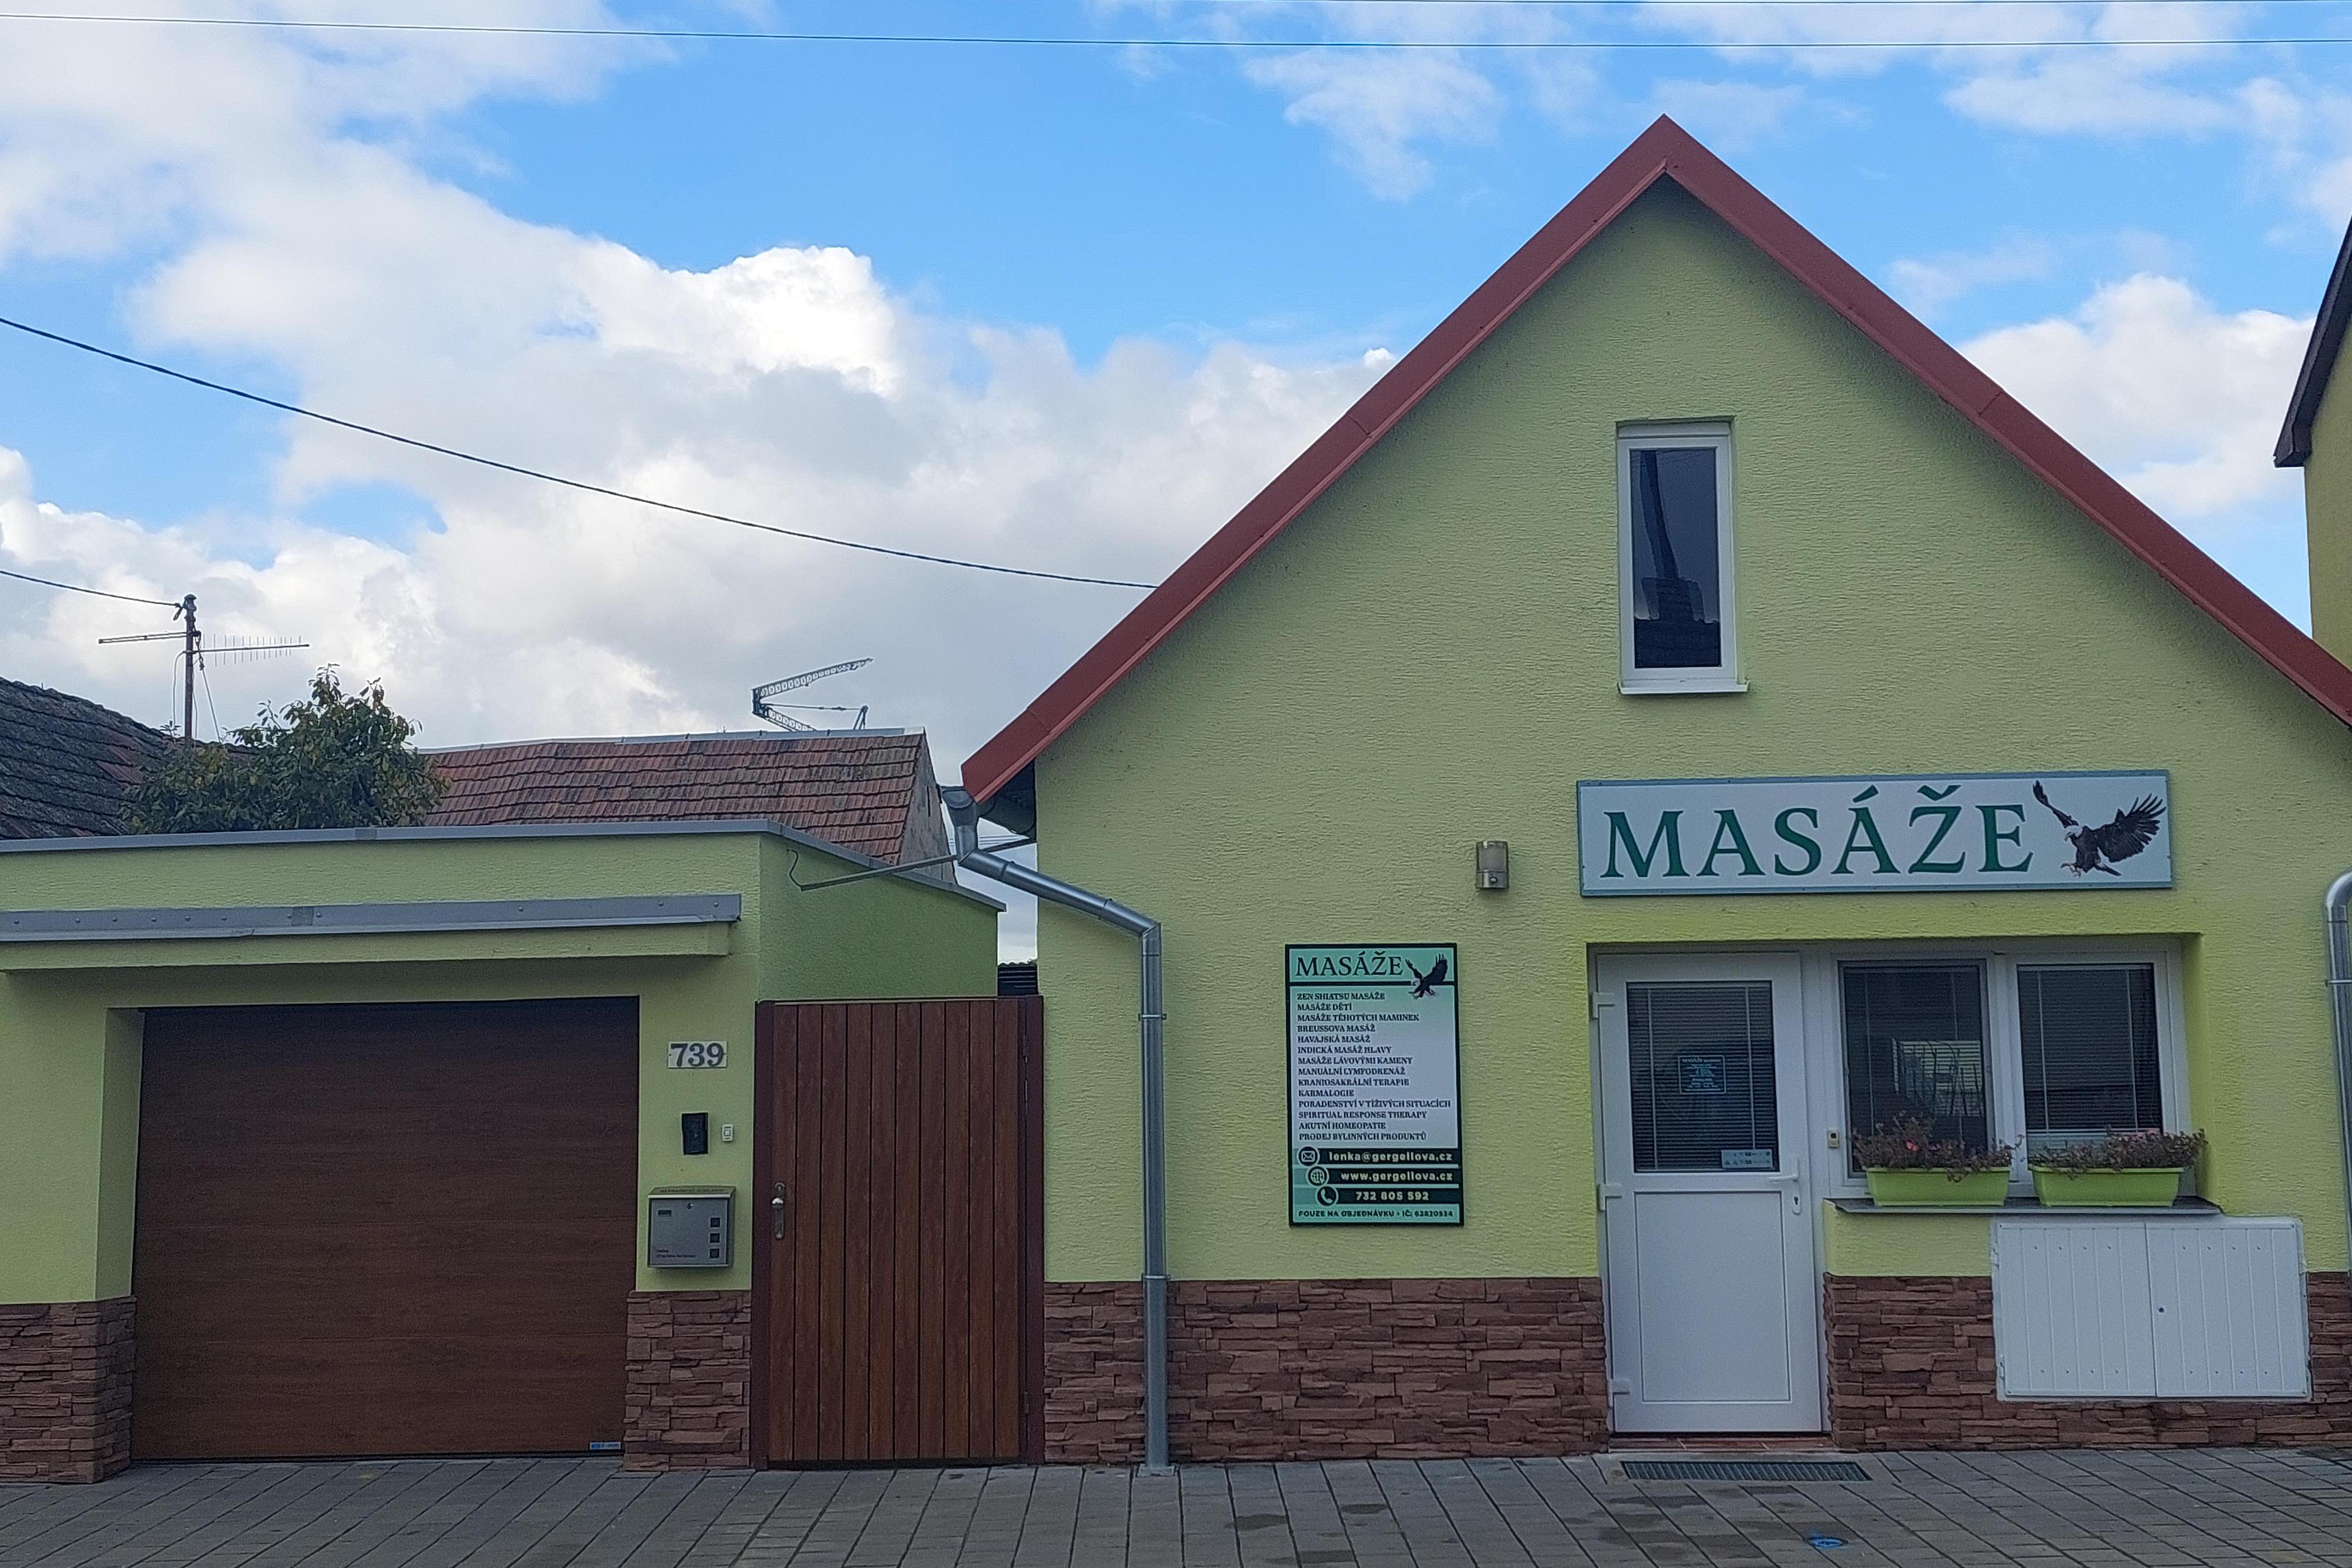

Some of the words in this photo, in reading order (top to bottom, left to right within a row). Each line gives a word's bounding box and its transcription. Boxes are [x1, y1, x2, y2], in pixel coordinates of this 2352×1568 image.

[1600, 784, 2034, 878] MASÁŽE
[1295, 950, 1404, 977] MASÁŽE
[1351, 992, 1385, 1000] MASÁŽE
[1297, 1002, 1331, 1011] MASÁŽE
[1332, 1002, 1352, 1011] DĚTÍ
[1297, 1014, 1332, 1022] MASÁŽE
[1332, 1013, 1378, 1022] TĚHOTÝCH
[1347, 1024, 1376, 1032] MASÁŽ
[1297, 1035, 1340, 1044] HAVAJSKÁ
[1341, 1034, 1371, 1044] MASÁŽ
[1298, 1045, 1333, 1054] INDICKÁ
[1334, 1045, 1363, 1054] MASÁŽ
[670, 1042, 724, 1068] 739
[1298, 1056, 1332, 1065] MASÁŽE
[1333, 1056, 1377, 1065] LÁVOVÝMI
[1298, 1066, 1343, 1075] MANUÁLNÍ
[1298, 1077, 1372, 1086] KRANIOSAKRÁLNÍ
[1298, 1099, 1357, 1108] PORADENSTVÍ
[1406, 1098, 1451, 1108] SITUACÍCH
[1298, 1120, 1331, 1129] AKUTNÍ
[1332, 1121, 1387, 1129] HOMEOPATIE
[1332, 1131, 1379, 1141] BYLINNÝCH
[1381, 1131, 1426, 1141] PRODUKTŮ
[1329, 1151, 1453, 1162] lenka@gergellova.cz
[1341, 1171, 1453, 1182] www.gergellova.cz
[1355, 1191, 1377, 1201] 732
[1381, 1191, 1404, 1201] 805
[1408, 1191, 1429, 1201] 592
[1341, 1208, 1395, 1217] OBJEDNÁVKU
